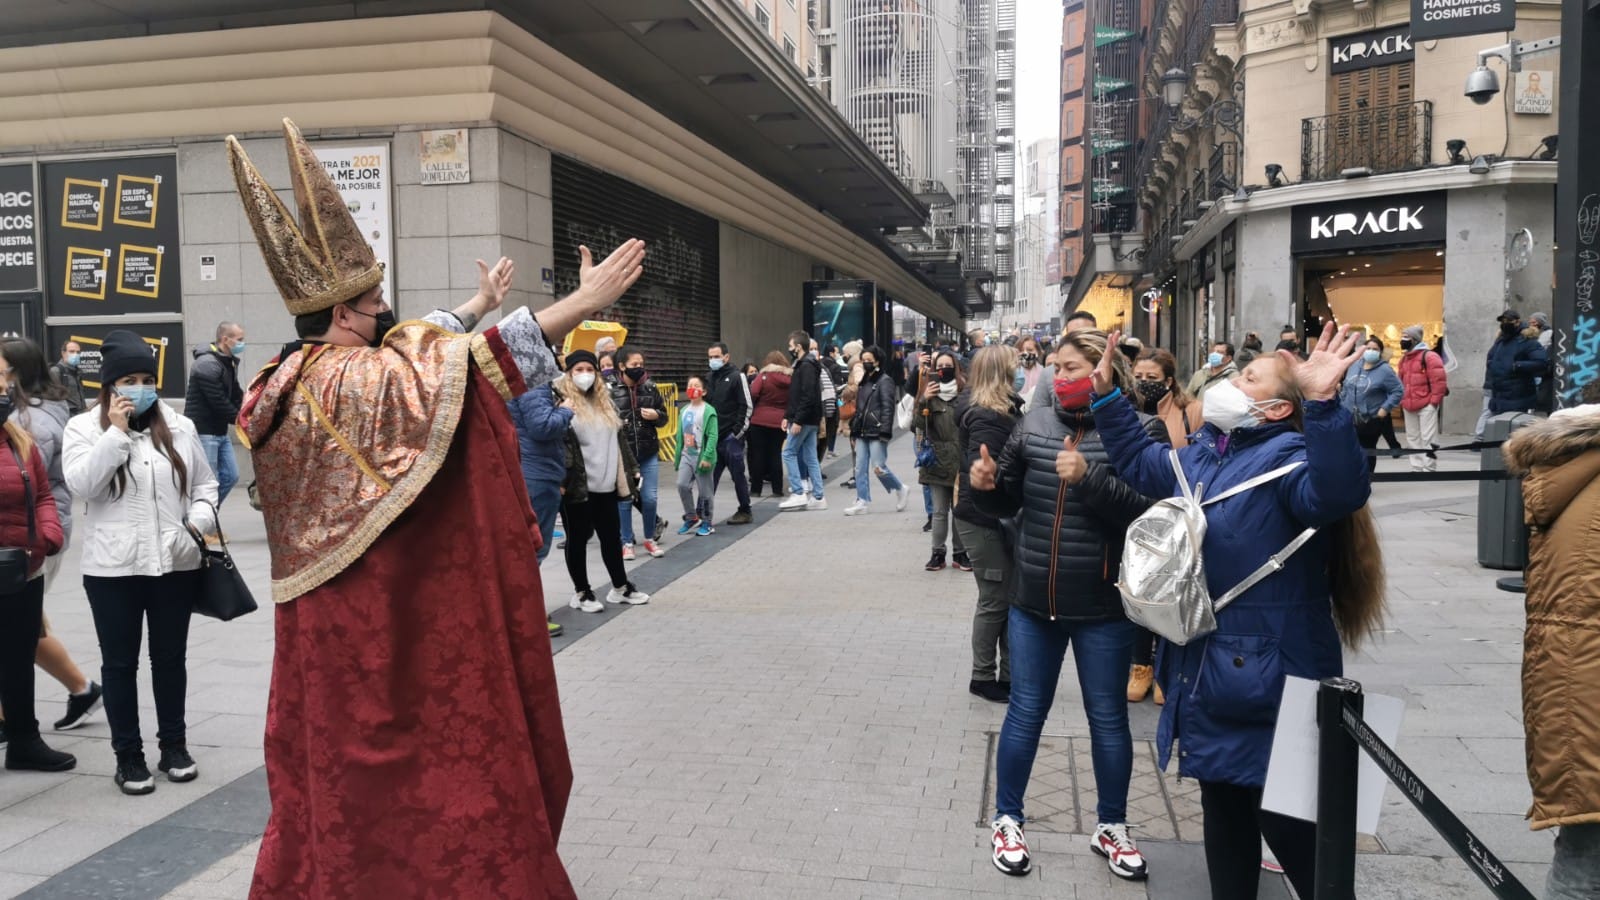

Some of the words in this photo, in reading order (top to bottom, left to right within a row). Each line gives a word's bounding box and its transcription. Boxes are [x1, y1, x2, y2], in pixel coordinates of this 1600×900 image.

[1423, 3, 1501, 21] COSMETICS
[1333, 34, 1412, 64] KRACK
[340, 160, 351, 168] EN
[353, 155, 381, 168] 2021
[338, 168, 381, 181] MEJOR
[349, 182, 382, 191] POSIBLE
[1310, 205, 1424, 239] KRACK
